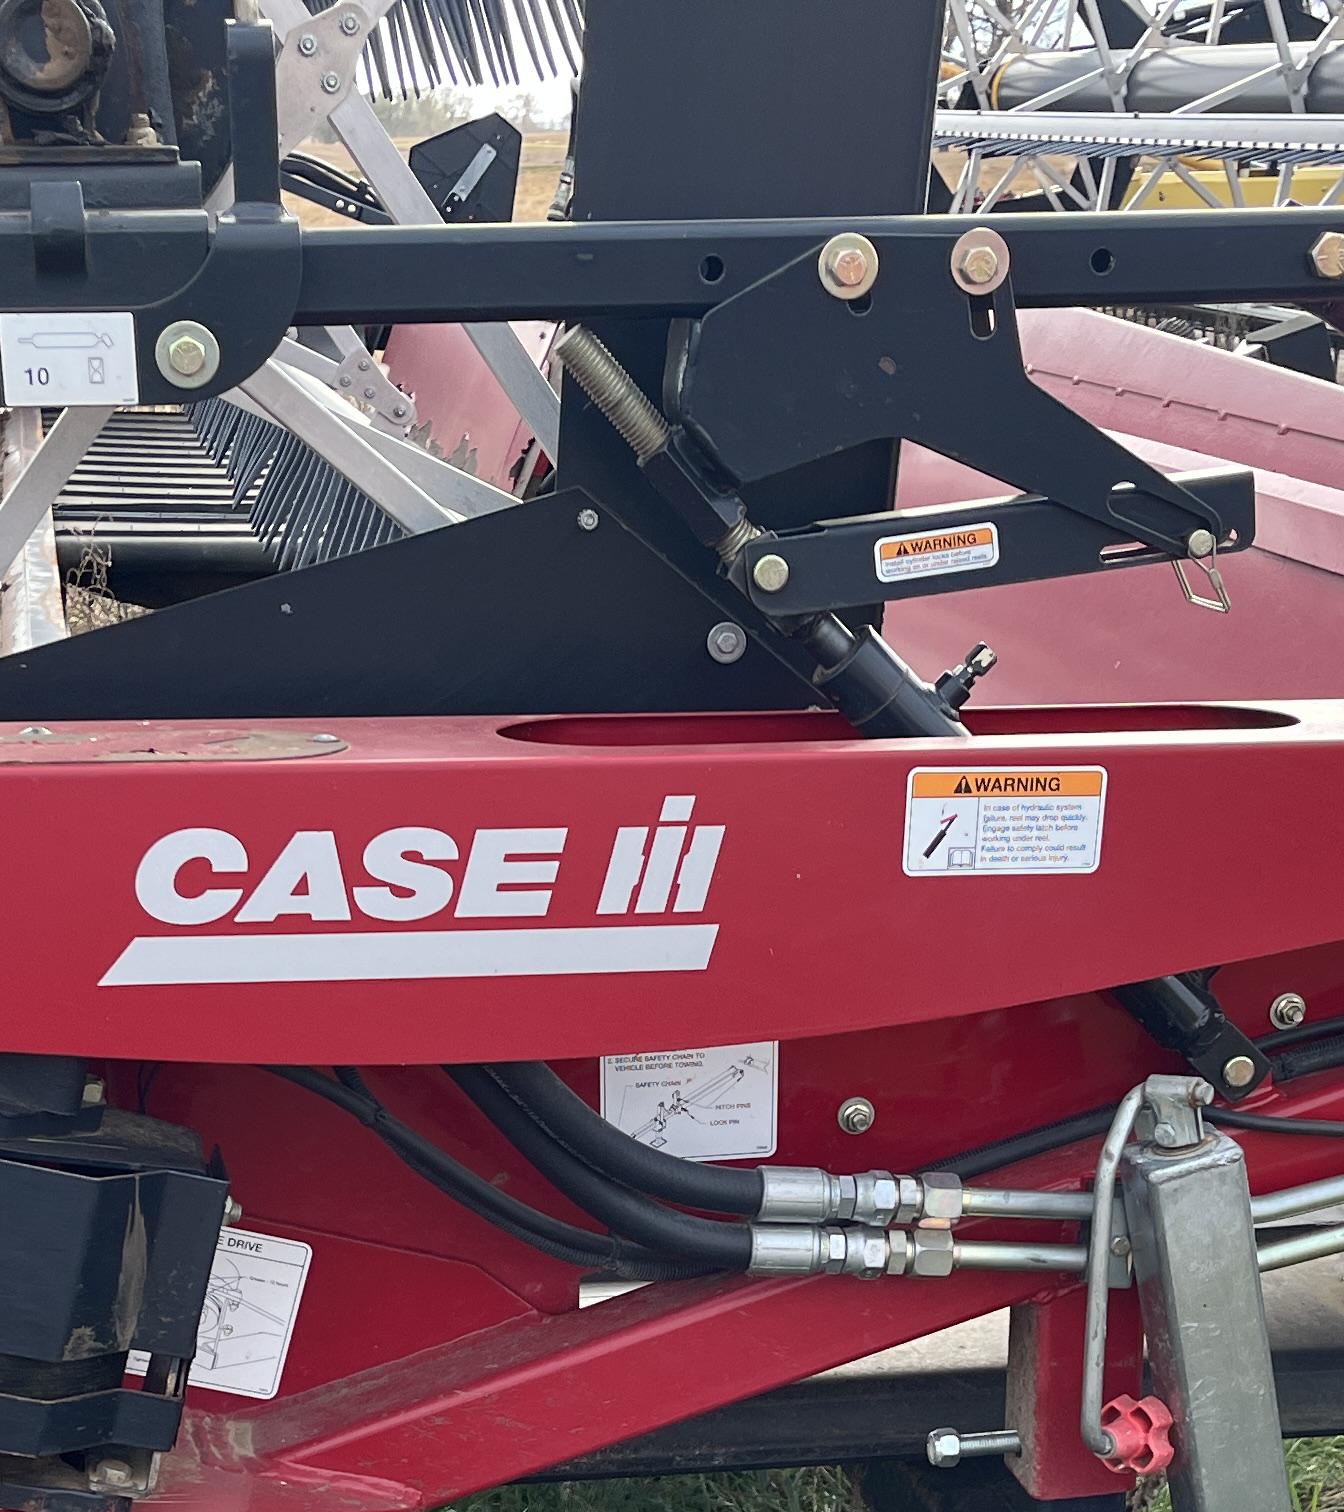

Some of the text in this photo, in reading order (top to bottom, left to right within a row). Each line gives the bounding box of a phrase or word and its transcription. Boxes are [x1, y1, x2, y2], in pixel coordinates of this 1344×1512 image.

[24, 367, 50, 386] 10
[910, 533, 976, 553] WARNING
[975, 777, 1060, 792] WARNING
[984, 804, 991, 812] In
[1021, 804, 1054, 812] hydraulic
[1009, 814, 1023, 822] reel
[1042, 814, 1059, 822] drop
[982, 825, 1010, 834] Engage
[1012, 824, 1034, 833] safety
[982, 835, 1010, 843] working
[1020, 854, 1046, 862] serious
[135, 826, 568, 925] CASE
[615, 1056, 642, 1064] SECURE
[644, 1054, 670, 1062] SAFETY
[614, 1064, 643, 1072] VEHICLE
[645, 1062, 673, 1070] BEFORE
[227, 1237, 263, 1253] DRIVE
